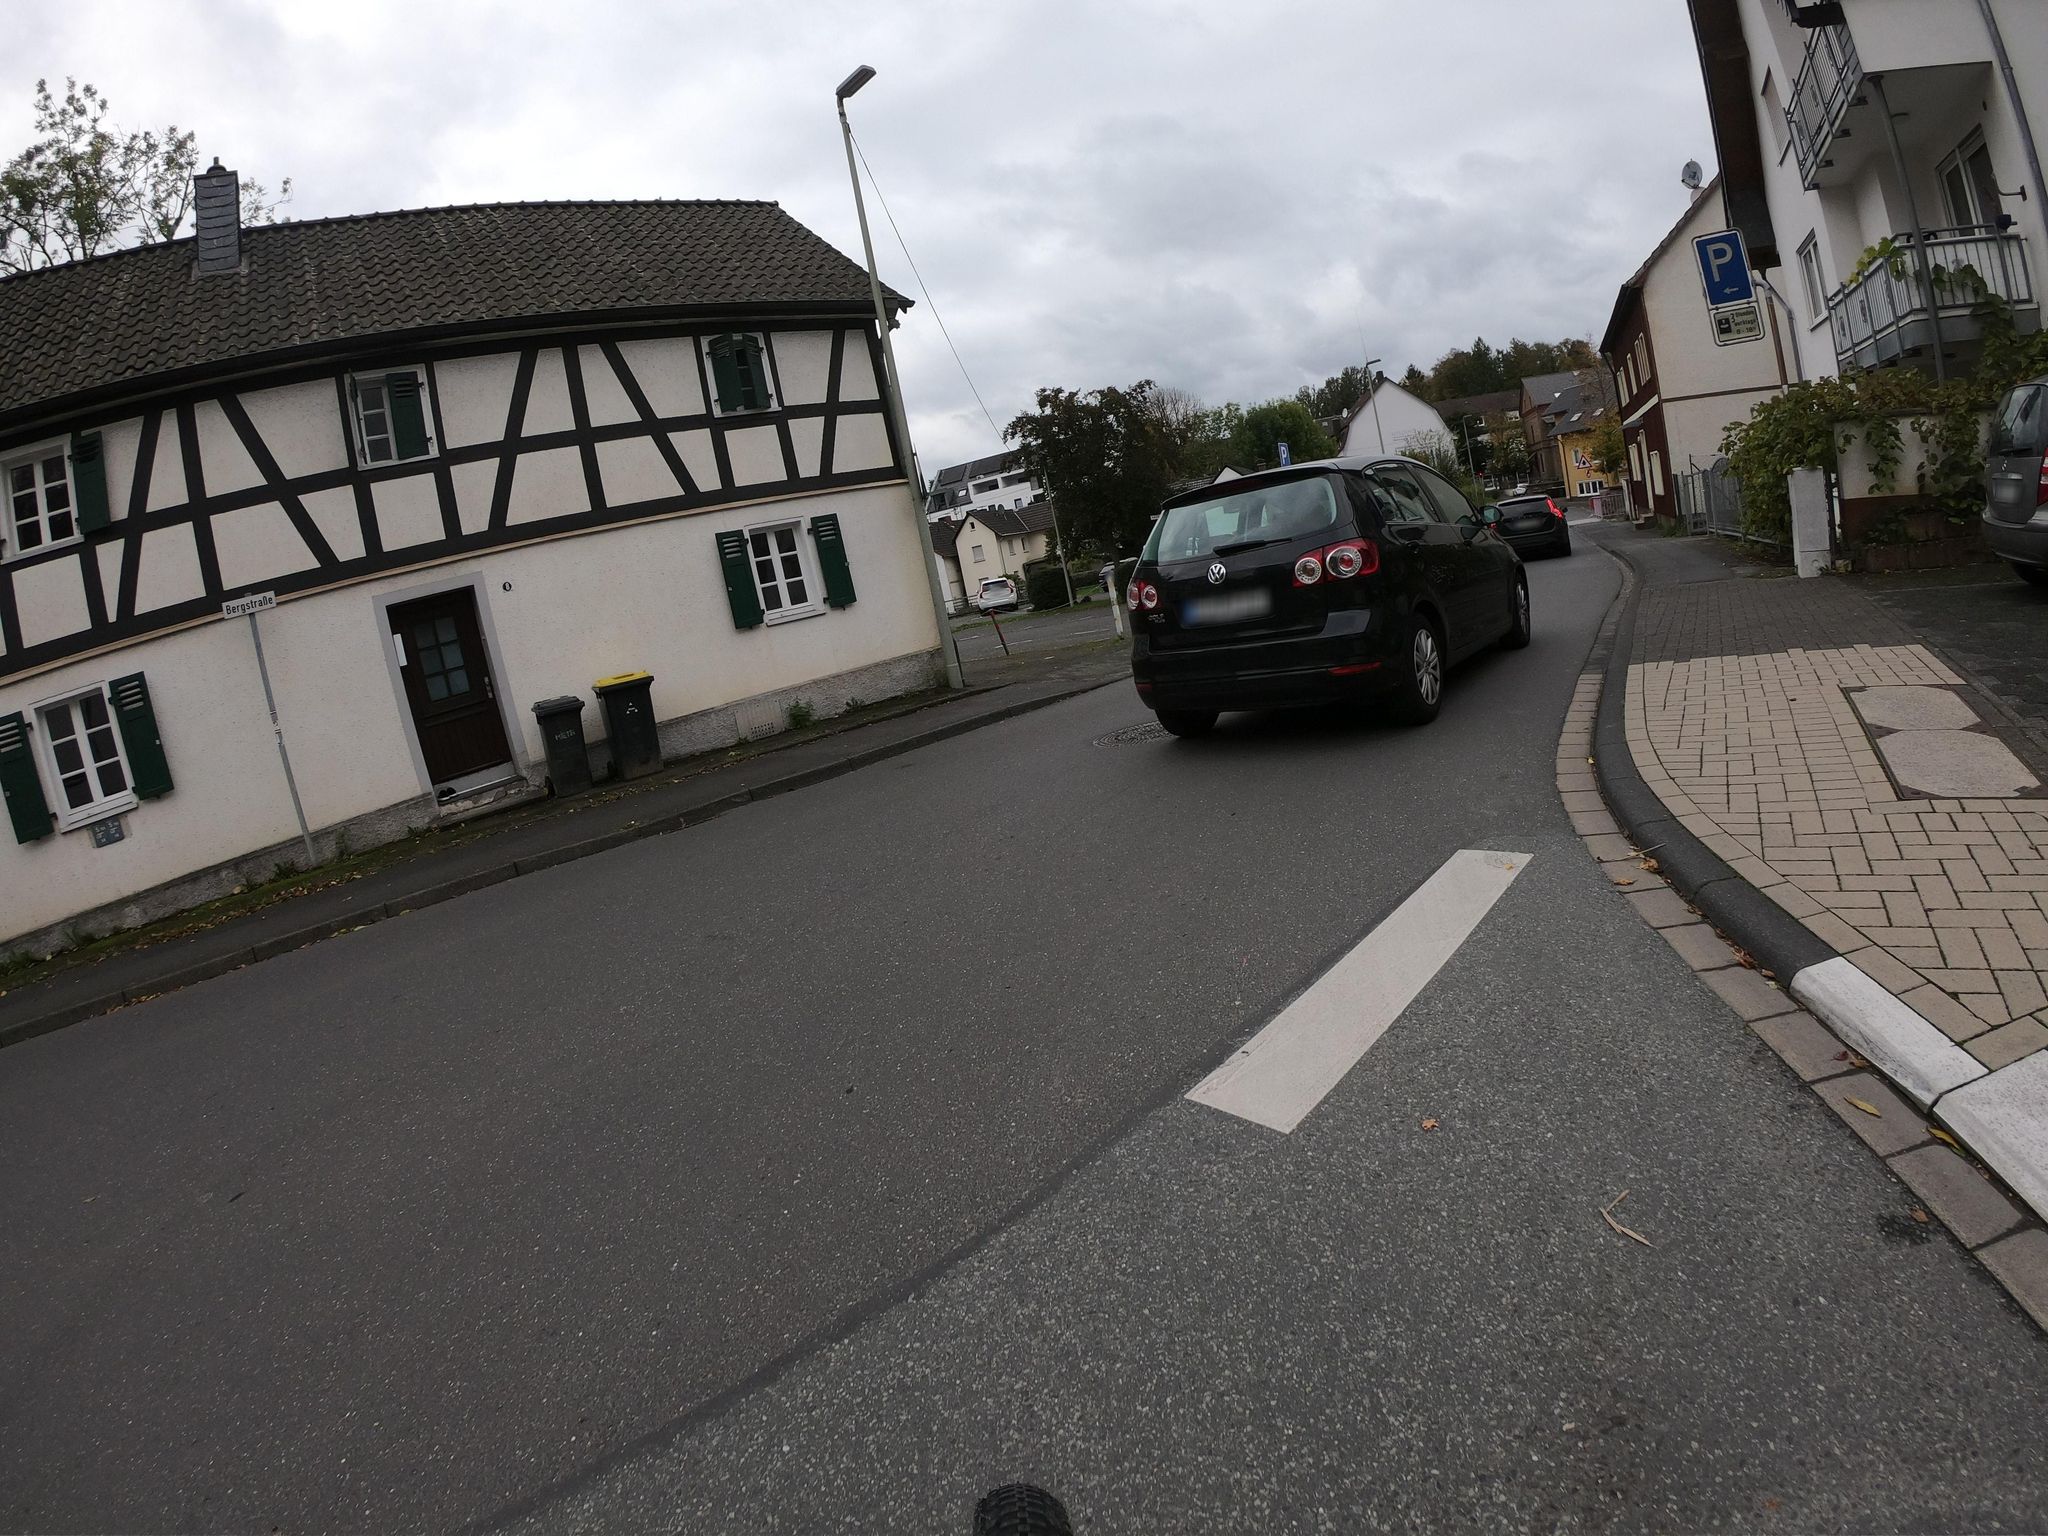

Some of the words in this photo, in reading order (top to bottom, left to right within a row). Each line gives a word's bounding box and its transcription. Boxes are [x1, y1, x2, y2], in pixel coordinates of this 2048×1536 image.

[1706, 242, 1733, 282] P
[1730, 313, 1736, 323] 3
[1280, 446, 1287, 465] P
[225, 595, 274, 615] Bergstraße
